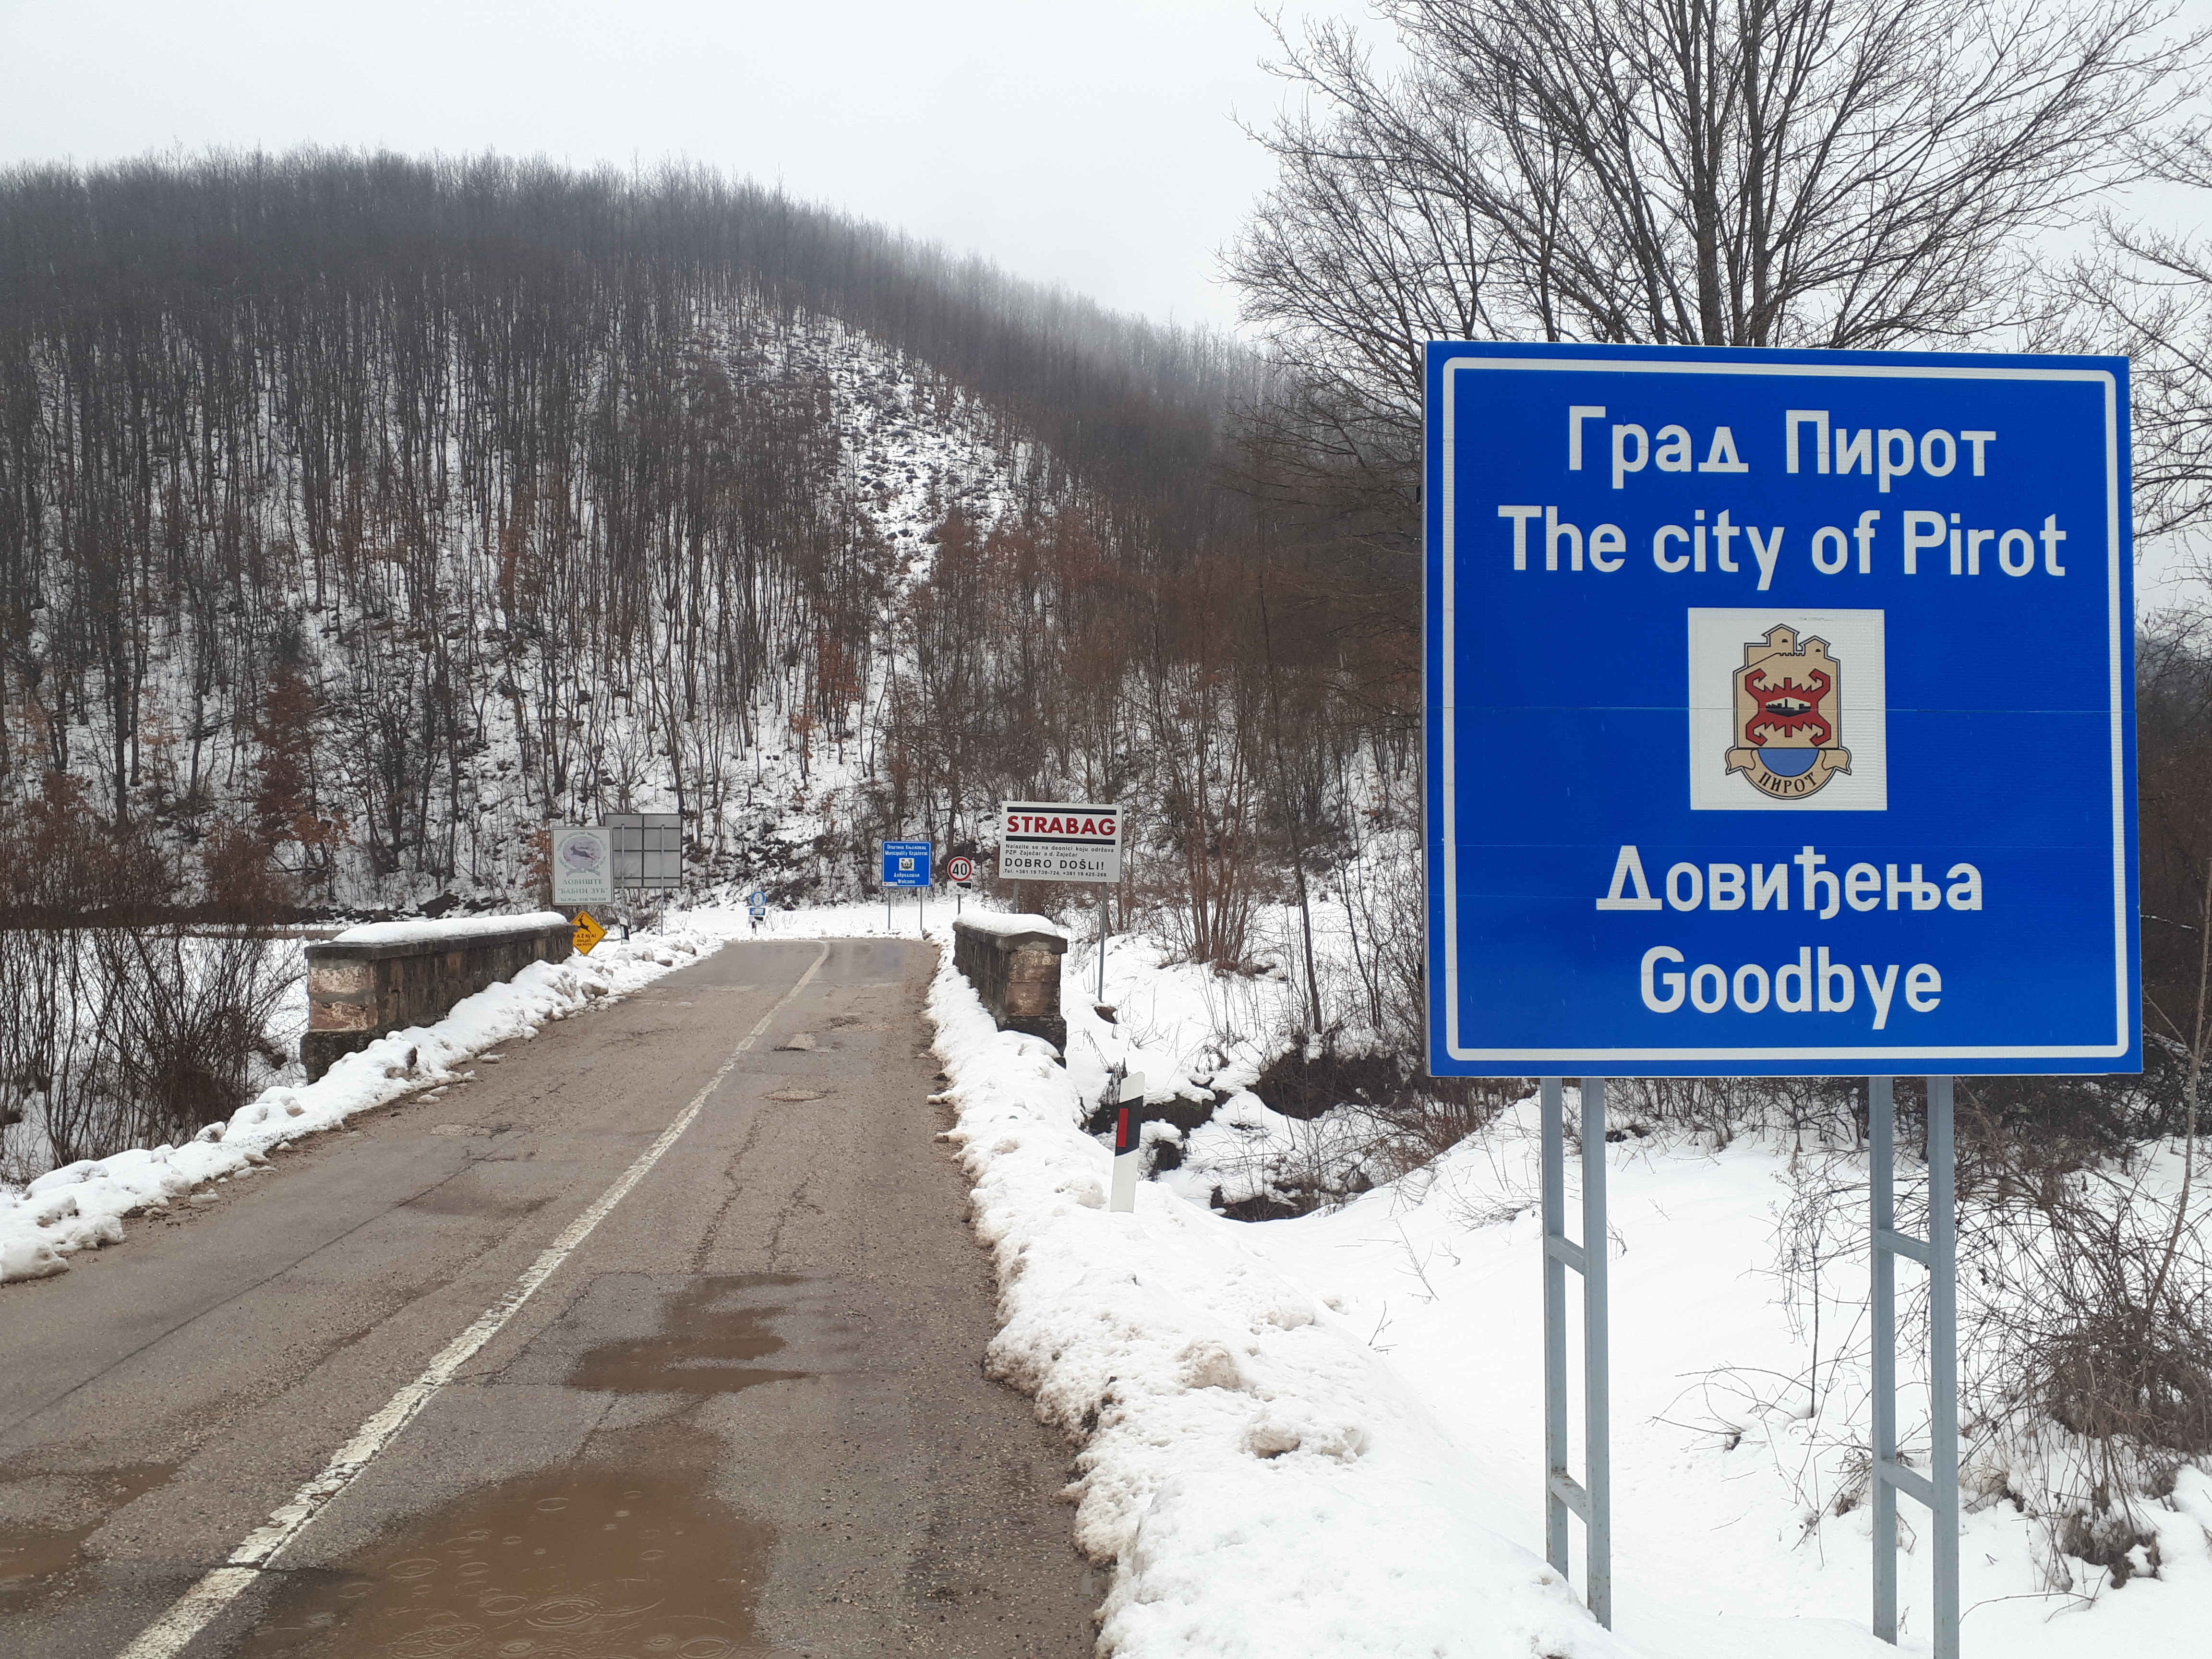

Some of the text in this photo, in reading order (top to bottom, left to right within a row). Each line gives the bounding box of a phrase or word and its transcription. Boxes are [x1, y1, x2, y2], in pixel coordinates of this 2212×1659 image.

[1569, 405, 1997, 493] Град Пирот
[1497, 505, 2067, 591] The city of Pirot
[1757, 771, 1818, 793] ПИРОТ
[1007, 816, 1116, 836] STRABAG
[952, 863, 967, 876] 40
[1005, 858, 1104, 870] DOBRO DOŠLI!
[1596, 845, 1984, 920] Довиђења
[1640, 945, 1942, 1030] Goodbye
